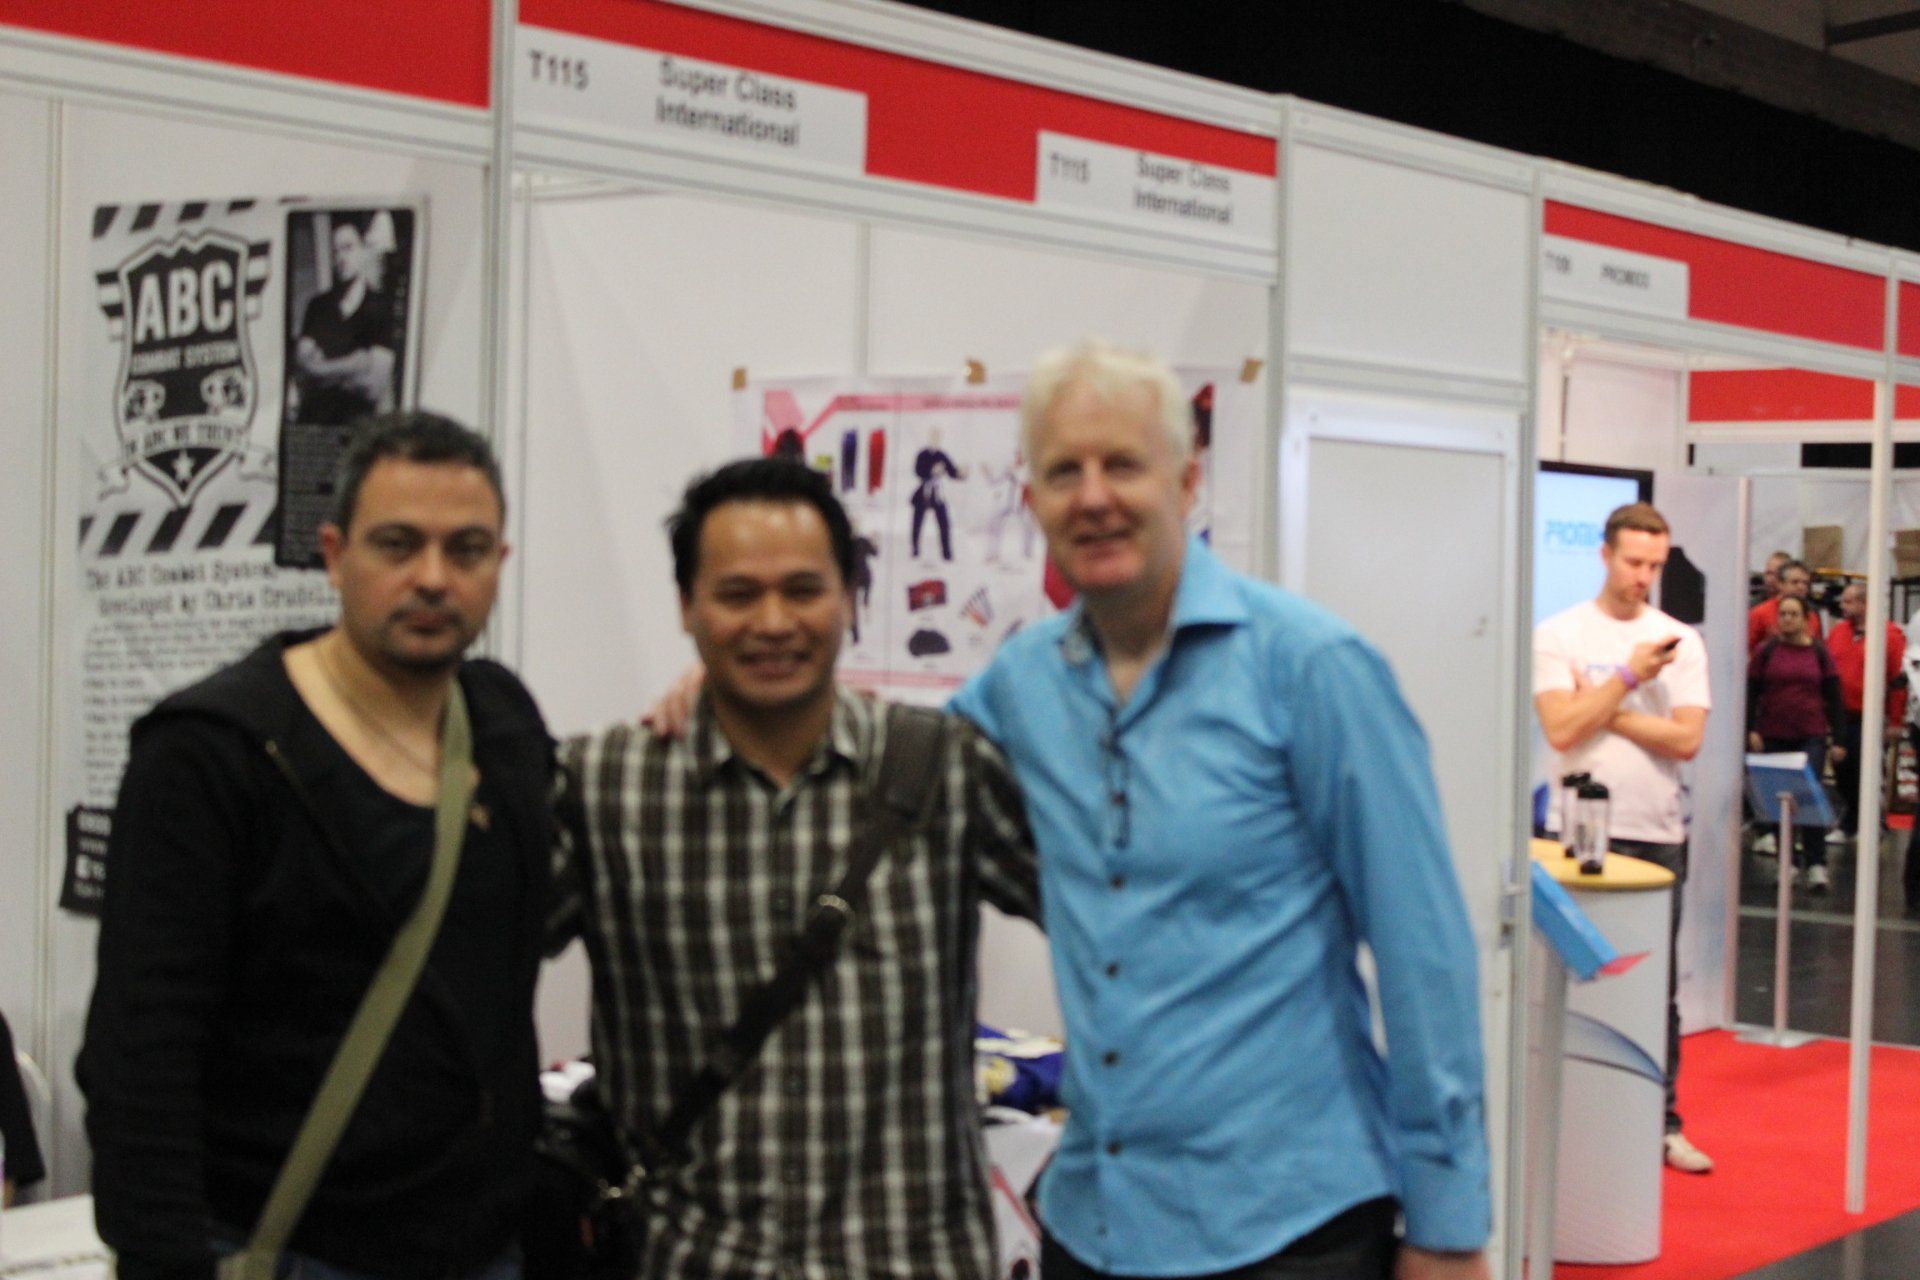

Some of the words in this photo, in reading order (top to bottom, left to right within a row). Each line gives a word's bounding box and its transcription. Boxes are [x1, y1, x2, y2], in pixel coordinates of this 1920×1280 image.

[529, 51, 588, 91] T115
[659, 57, 727, 96] Super
[734, 74, 796, 110] Class
[656, 98, 797, 147] International
[134, 260, 234, 344] ABC
